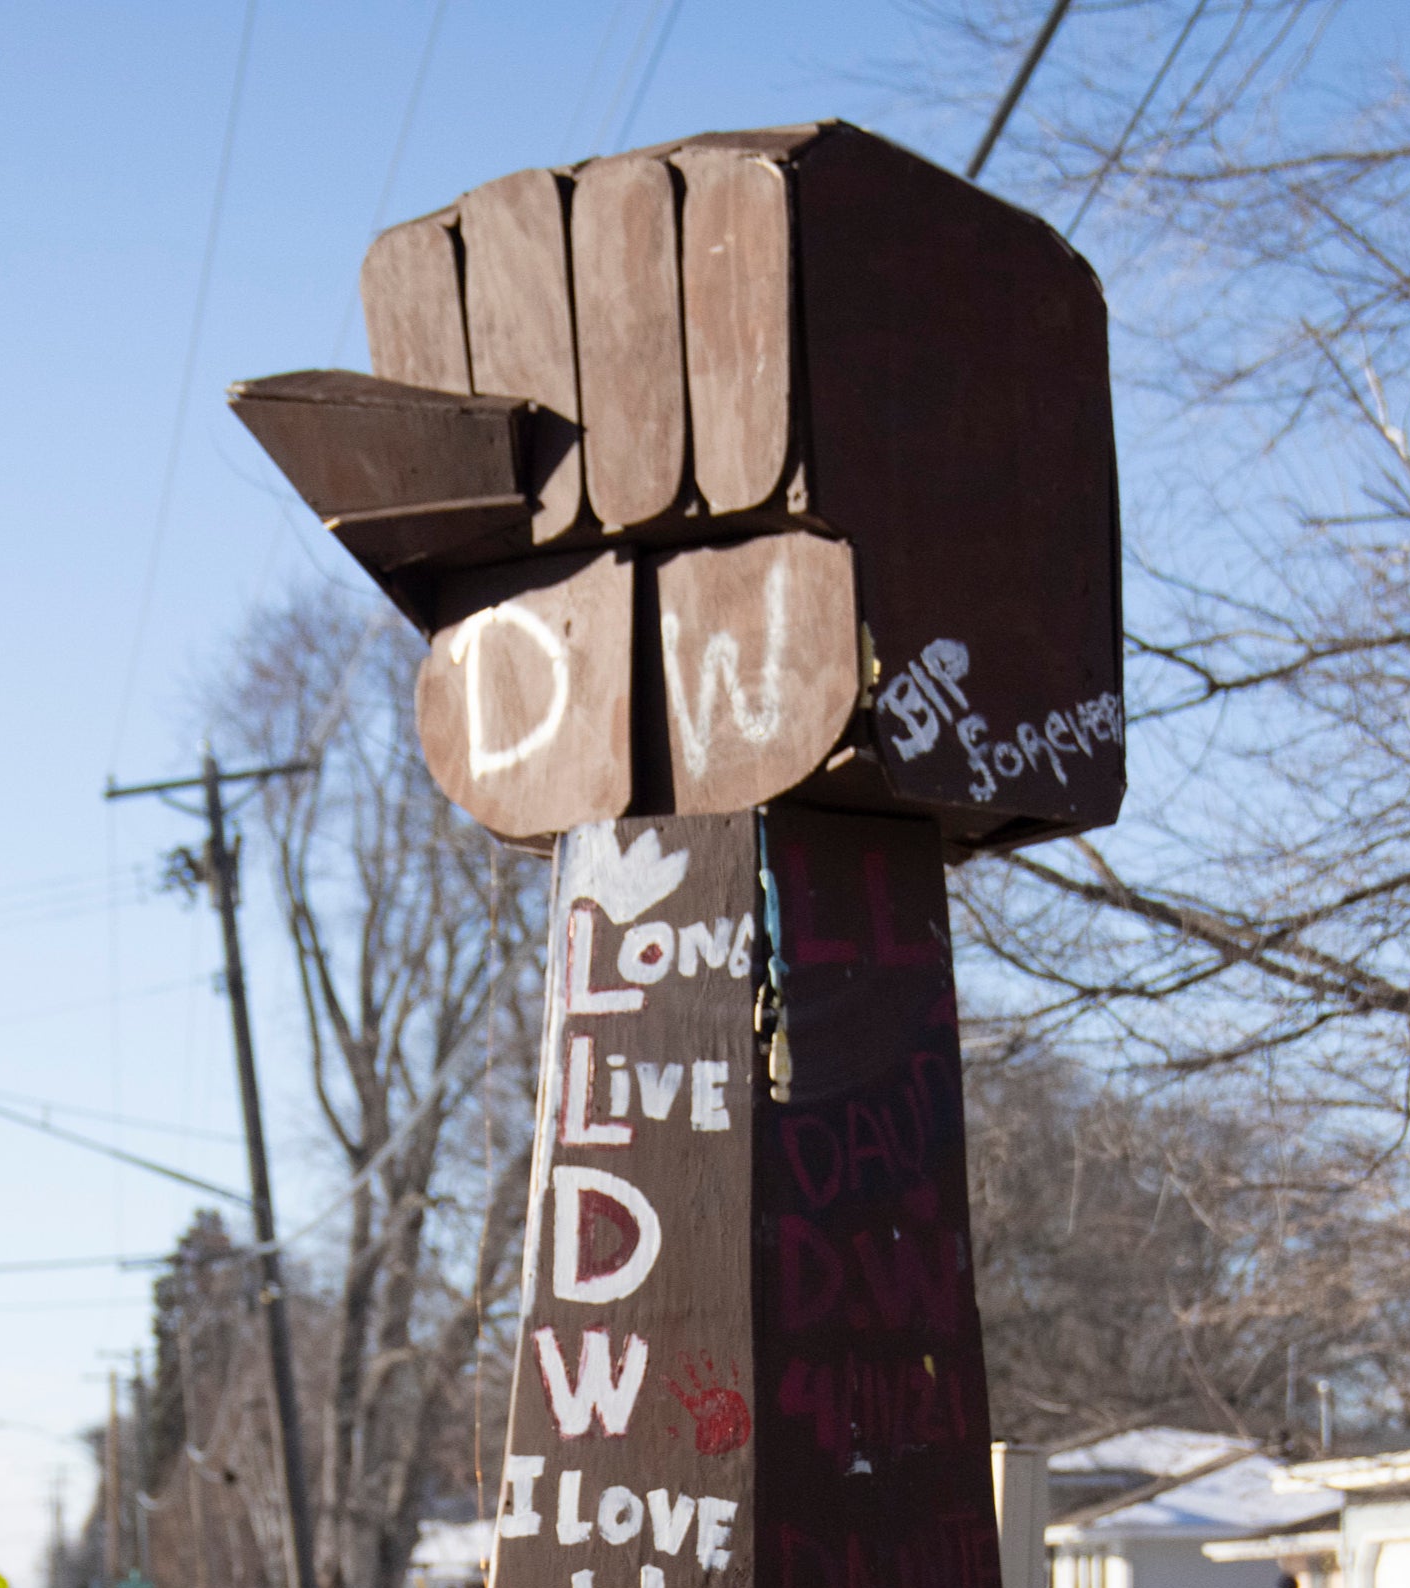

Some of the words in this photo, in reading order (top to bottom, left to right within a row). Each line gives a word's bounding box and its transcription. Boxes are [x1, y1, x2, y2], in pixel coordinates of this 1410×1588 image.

[451, 601, 569, 782] D
[660, 555, 788, 782] W
[553, 1165, 661, 1303] D
[534, 1324, 648, 1440] W
[501, 1455, 545, 1538] I
[556, 1469, 739, 1572] LOVE
